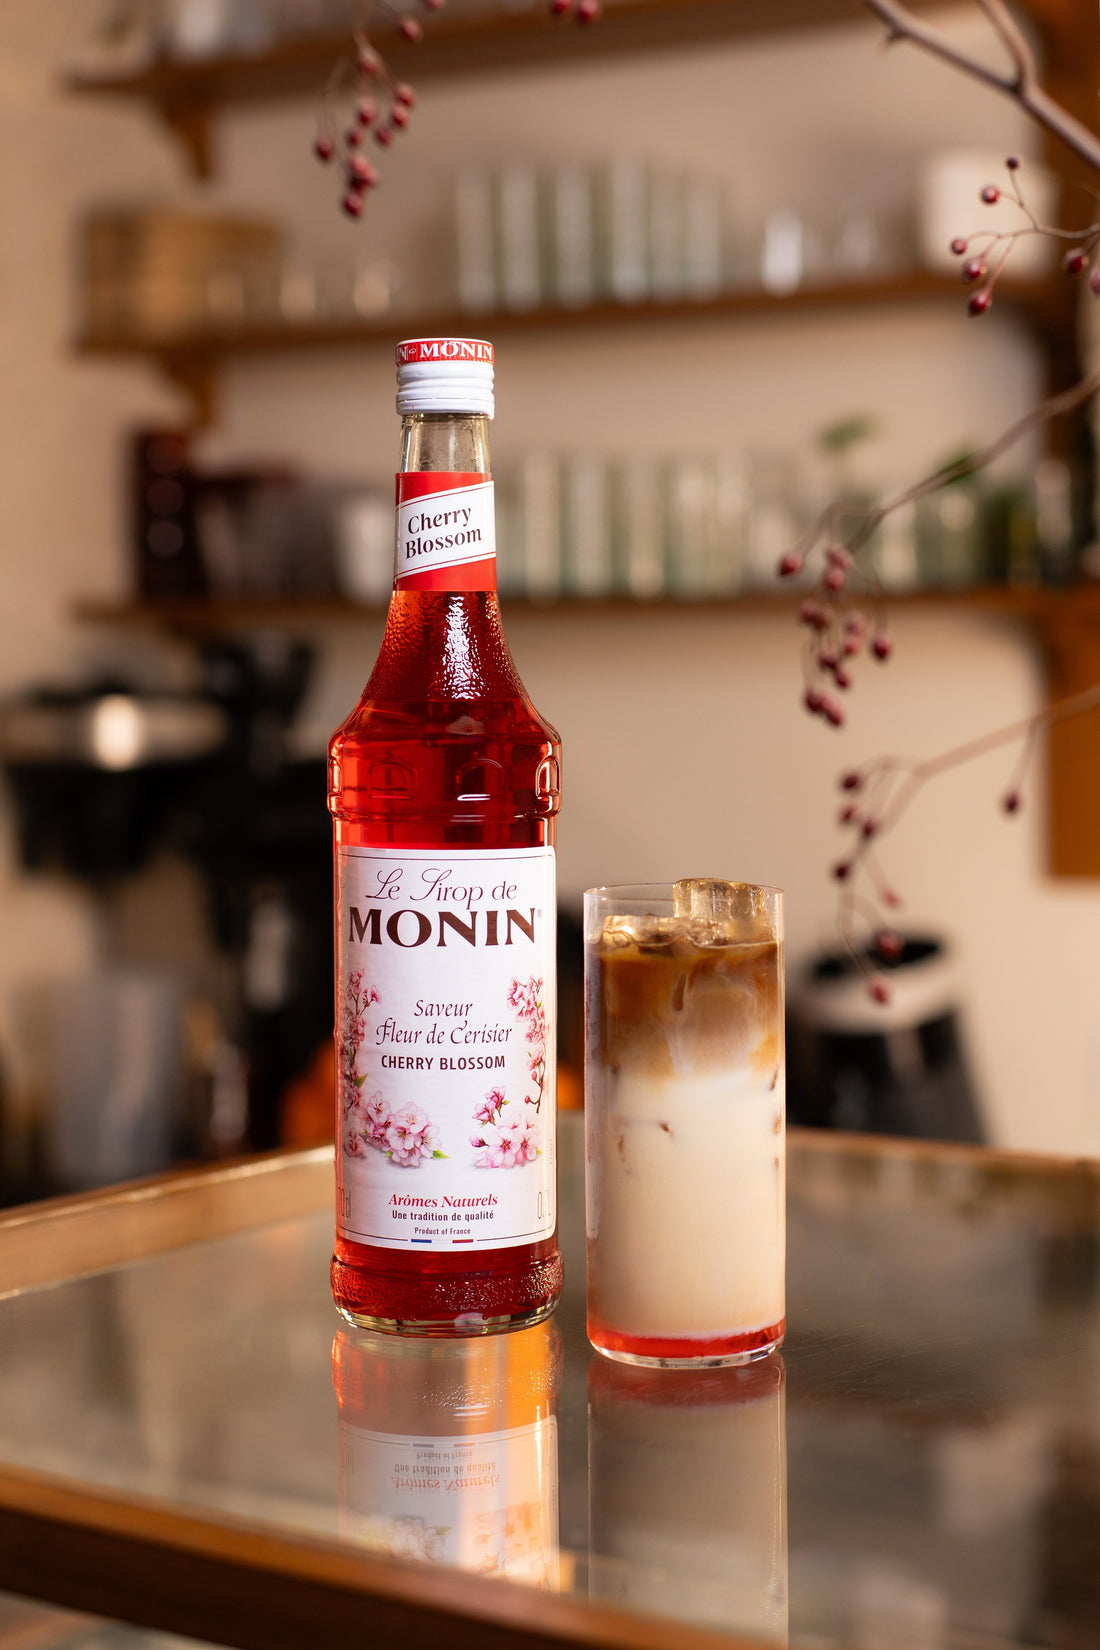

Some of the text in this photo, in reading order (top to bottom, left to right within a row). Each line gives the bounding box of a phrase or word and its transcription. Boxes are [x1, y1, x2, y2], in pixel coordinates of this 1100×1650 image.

[420, 342, 492, 361] MONIN
[408, 508, 471, 534] Cherry
[406, 528, 482, 559] Blossom
[365, 868, 517, 910] Le Sirop de
[414, 1000, 473, 1017] Saveur
[376, 1017, 512, 1045] Fleur de Cerisier
[381, 1055, 505, 1070] CHERRY BLOSSOM
[388, 1193, 498, 1208] Arômes Naturels
[392, 1210, 494, 1223] Une tradition de qualité
[414, 1227, 439, 1235] Product
[450, 1227, 471, 1235] France
